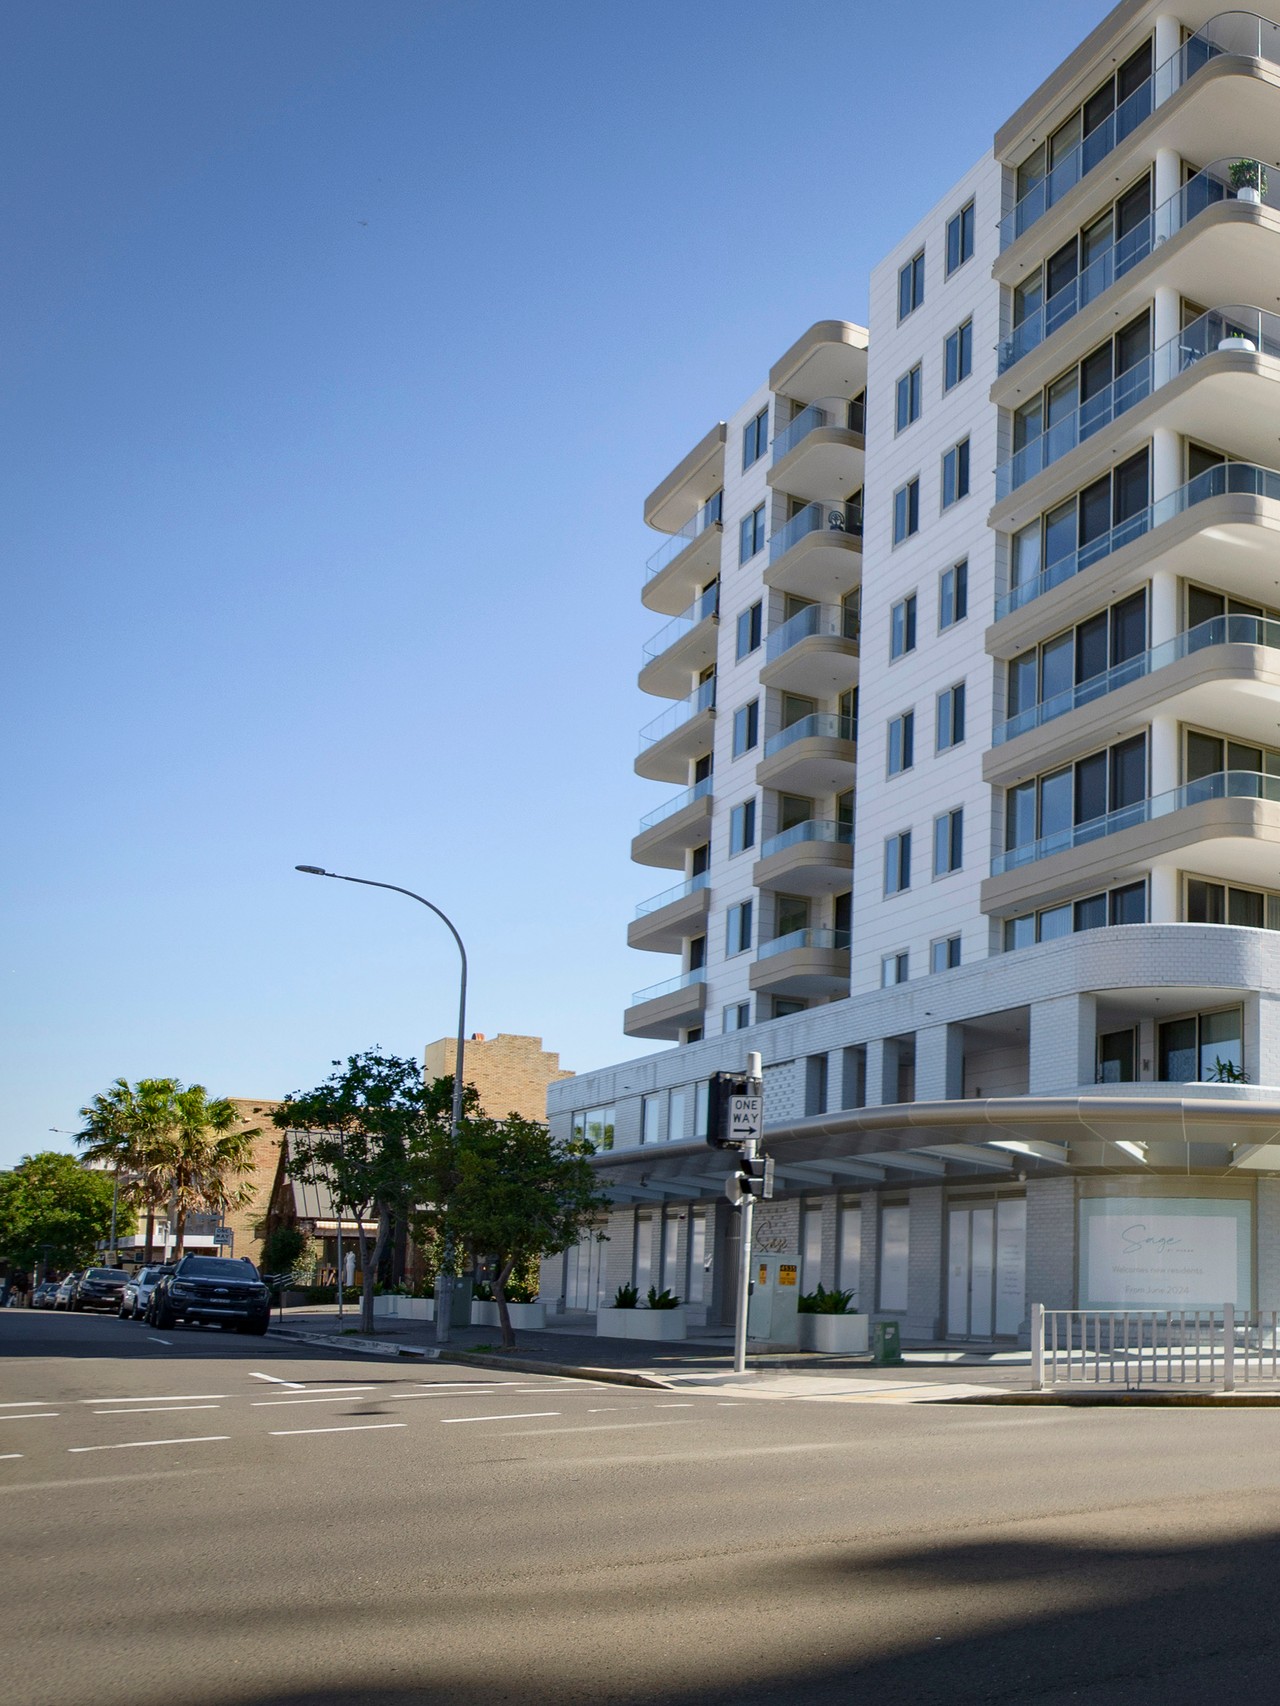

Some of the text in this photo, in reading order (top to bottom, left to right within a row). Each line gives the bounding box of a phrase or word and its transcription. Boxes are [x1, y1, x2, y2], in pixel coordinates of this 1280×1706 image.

[736, 1100, 757, 1110] ONE
[733, 1114, 759, 1123] WAY
[1121, 1224, 1182, 1254] Sage
[1112, 1264, 1149, 1274] Welcomes
[1125, 1285, 1190, 1294] From June 2024
